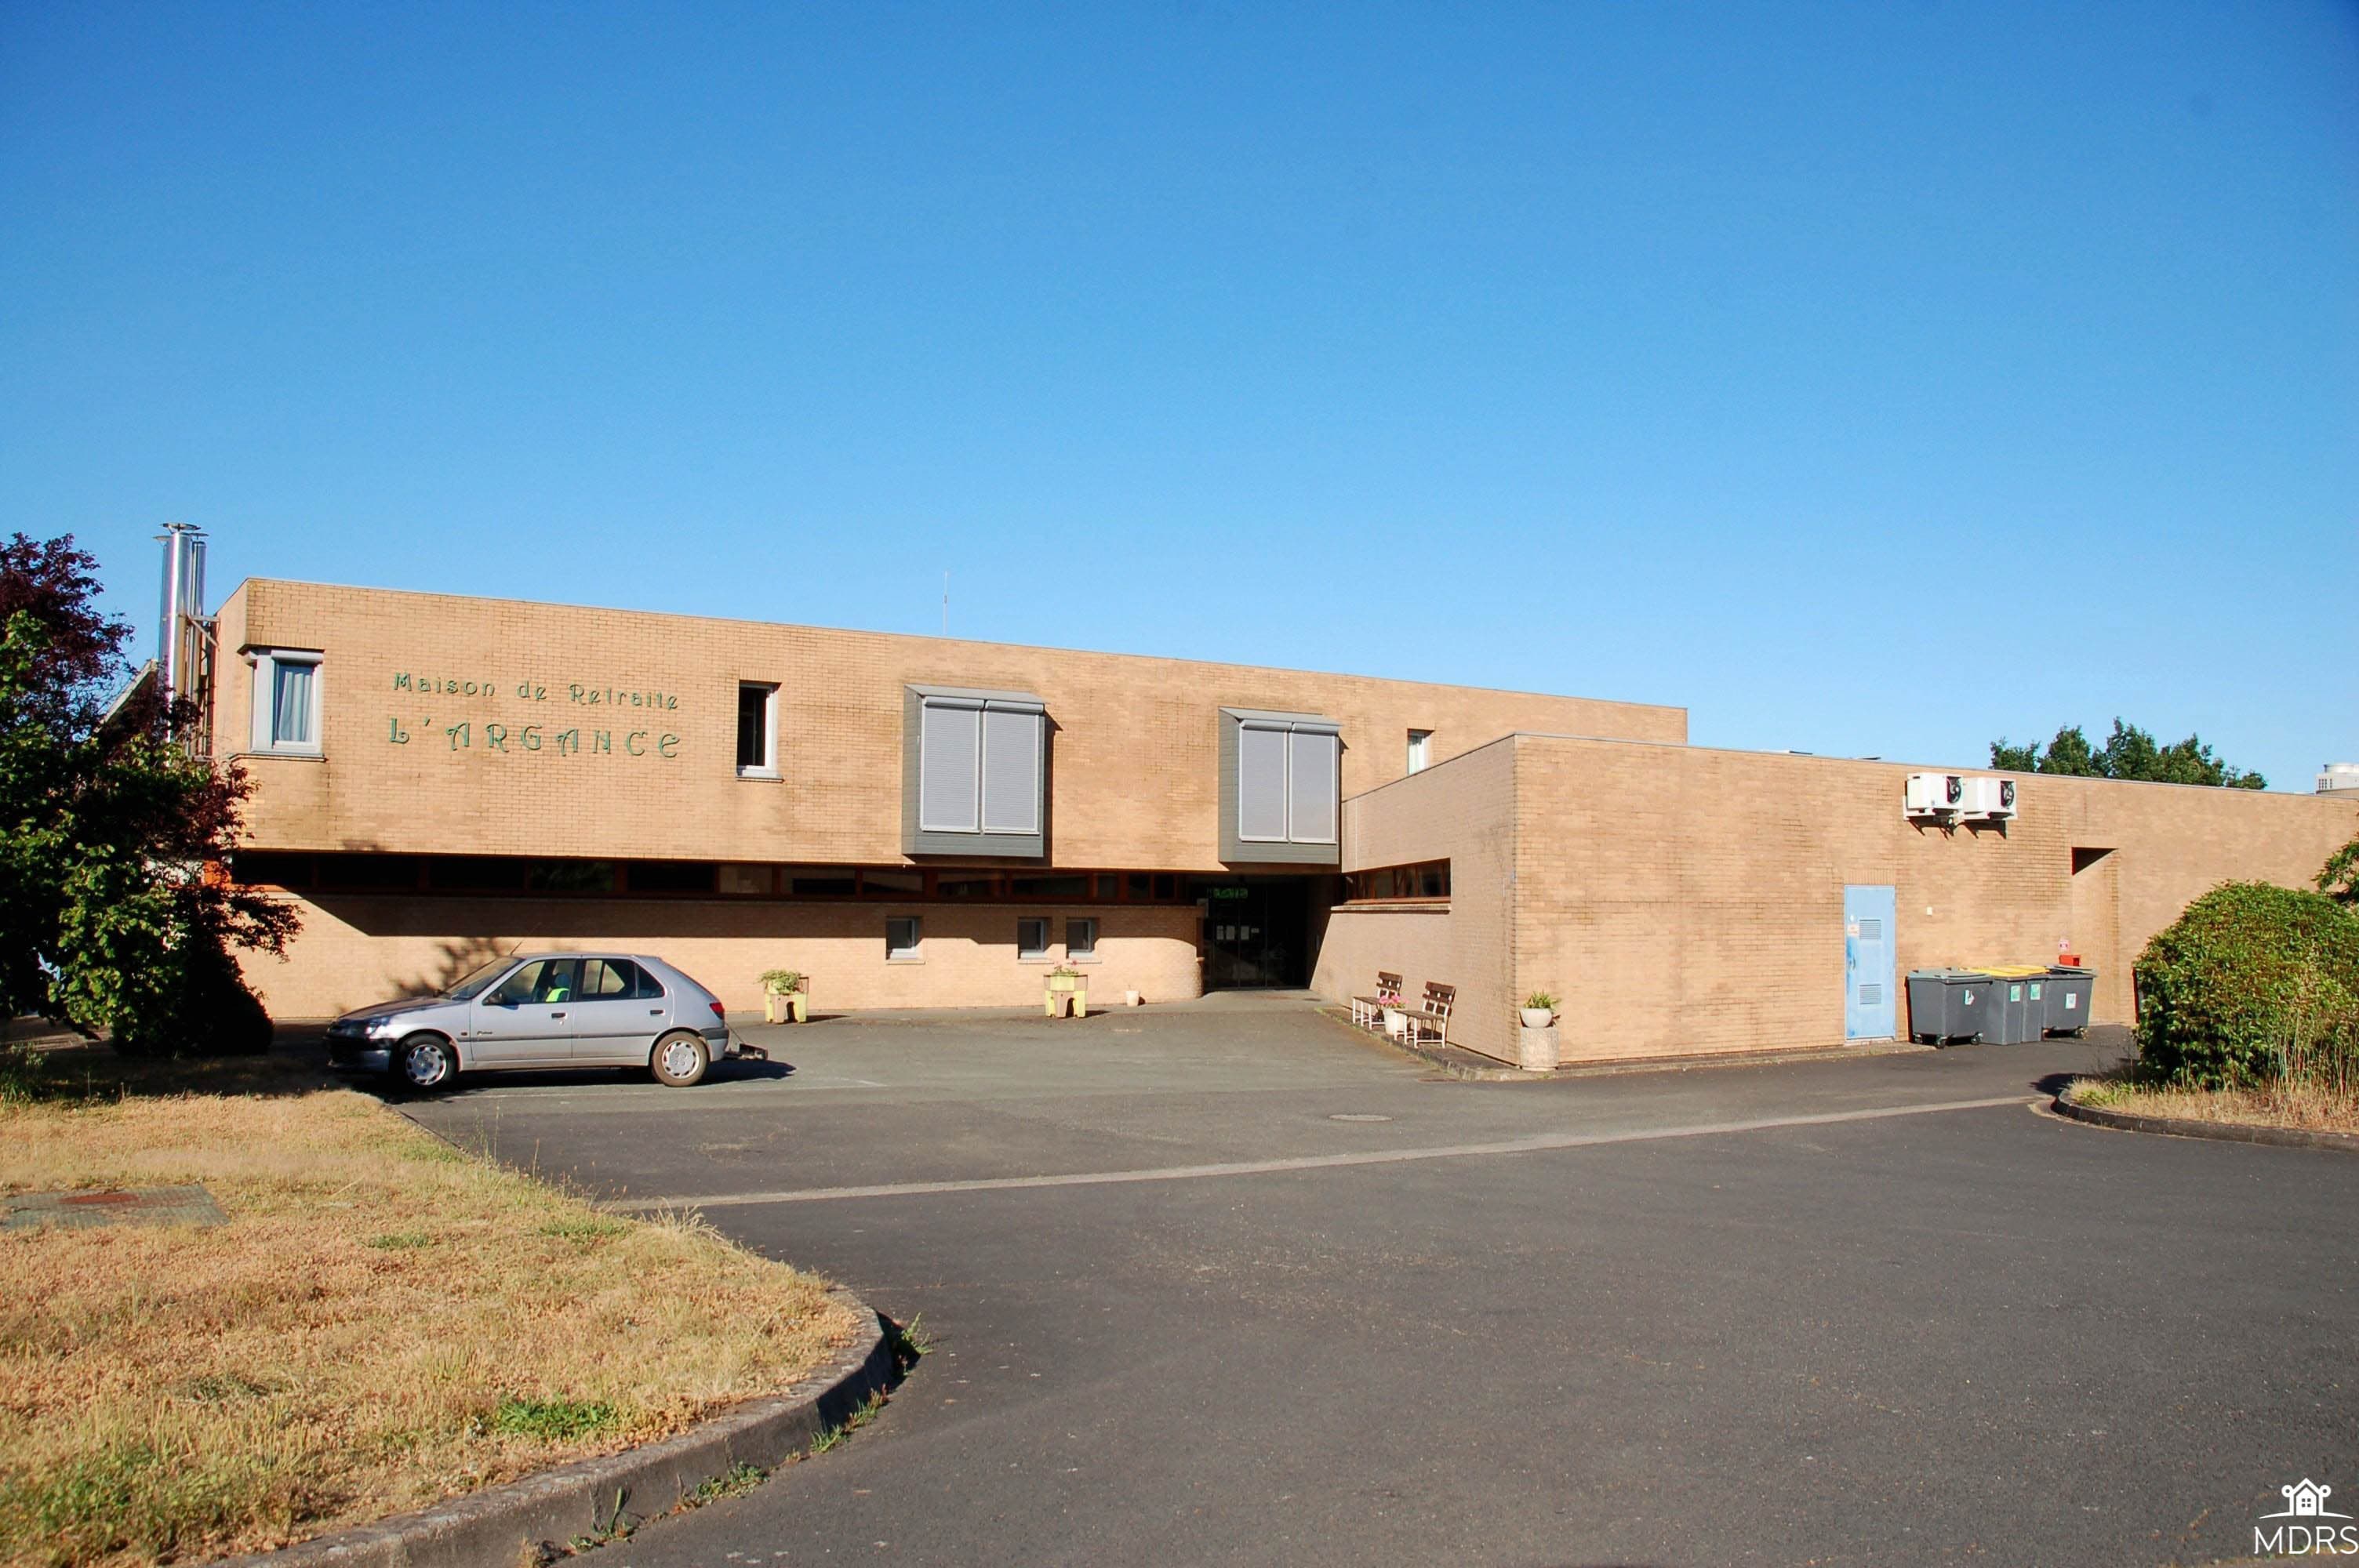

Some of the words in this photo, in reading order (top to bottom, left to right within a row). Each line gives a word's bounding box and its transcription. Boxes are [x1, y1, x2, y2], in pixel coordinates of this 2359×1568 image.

[394, 672, 495, 696] Maison
[517, 681, 547, 700] de
[569, 684, 678, 710] Retraite
